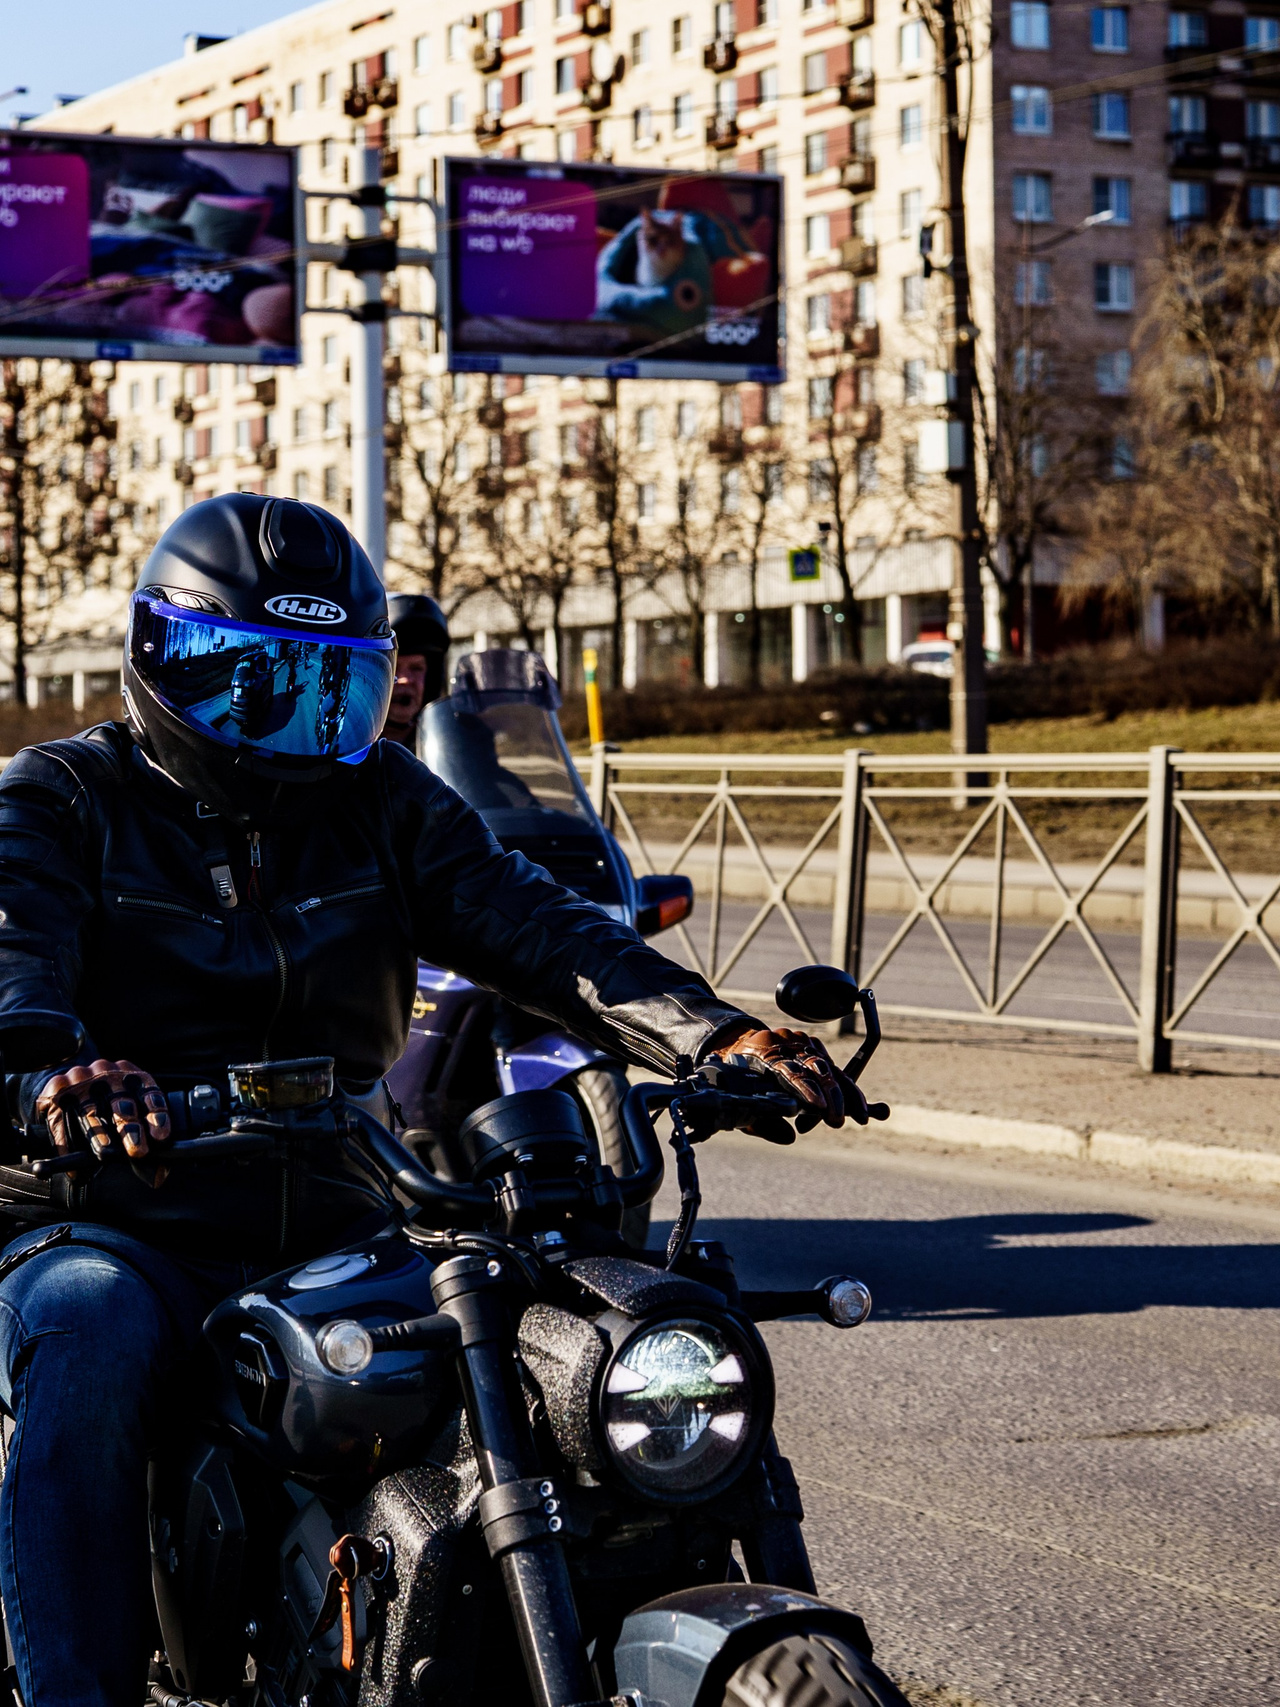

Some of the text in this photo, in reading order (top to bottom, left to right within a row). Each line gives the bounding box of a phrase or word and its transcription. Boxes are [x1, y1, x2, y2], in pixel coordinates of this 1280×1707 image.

[468, 186, 526, 205] люди
[468, 206, 578, 233] выбирают
[467, 235, 497, 252] на
[277, 600, 337, 619] HJC
